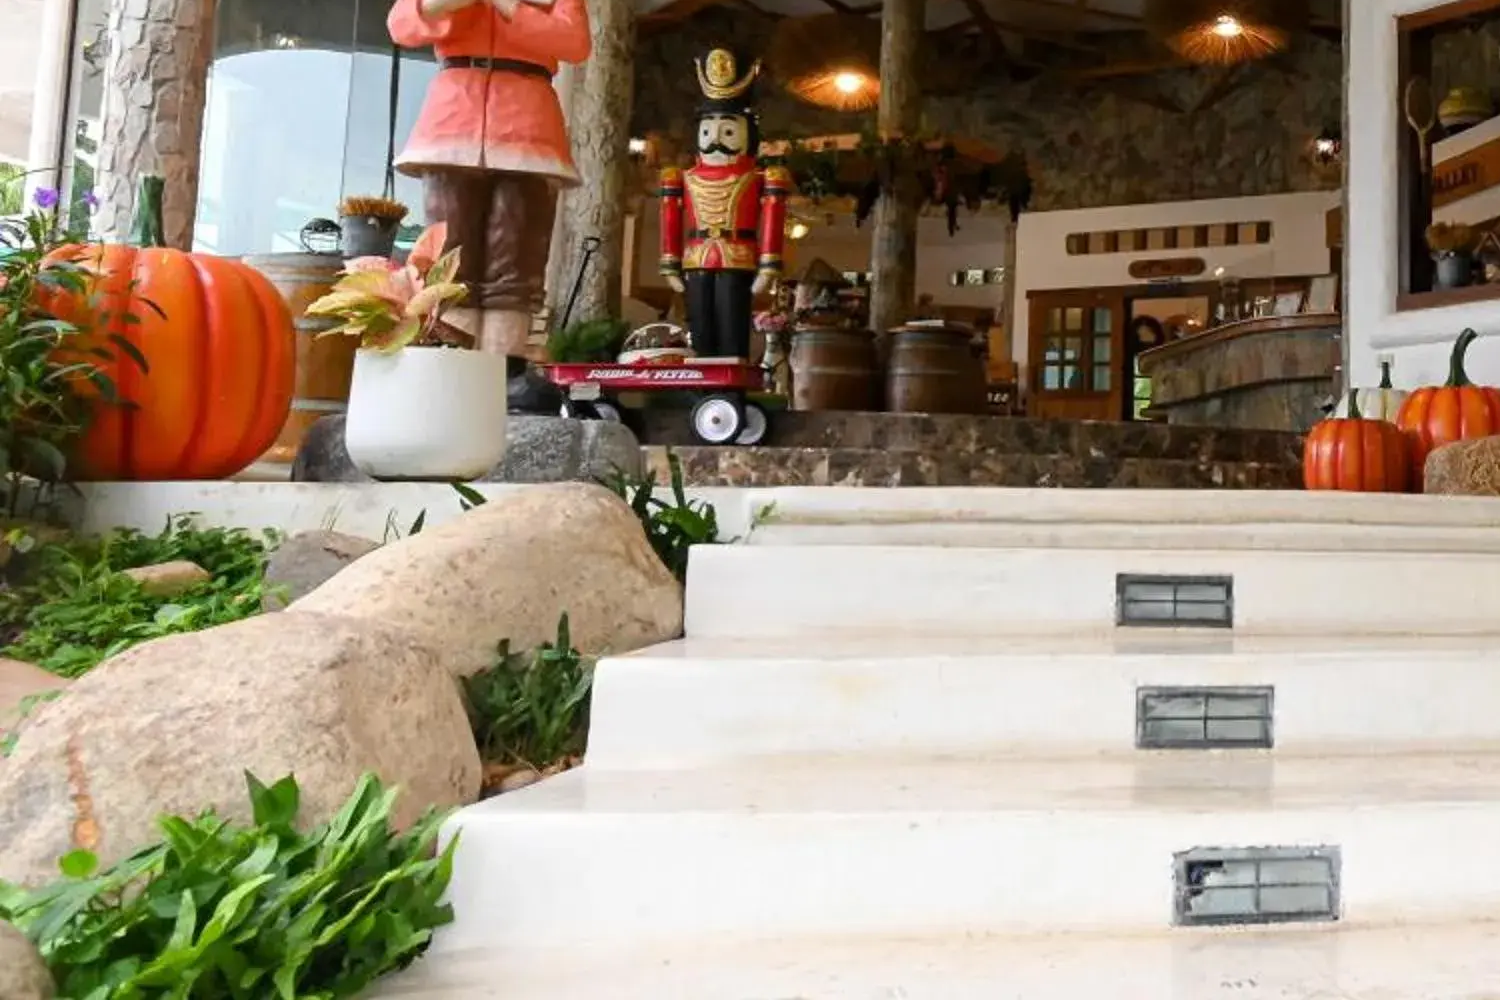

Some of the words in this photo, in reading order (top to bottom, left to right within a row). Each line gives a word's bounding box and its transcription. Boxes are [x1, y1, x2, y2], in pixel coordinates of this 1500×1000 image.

[1432, 163, 1479, 194] ALLEY
[586, 369, 634, 379] RADIO
[654, 369, 704, 379] FLYER
